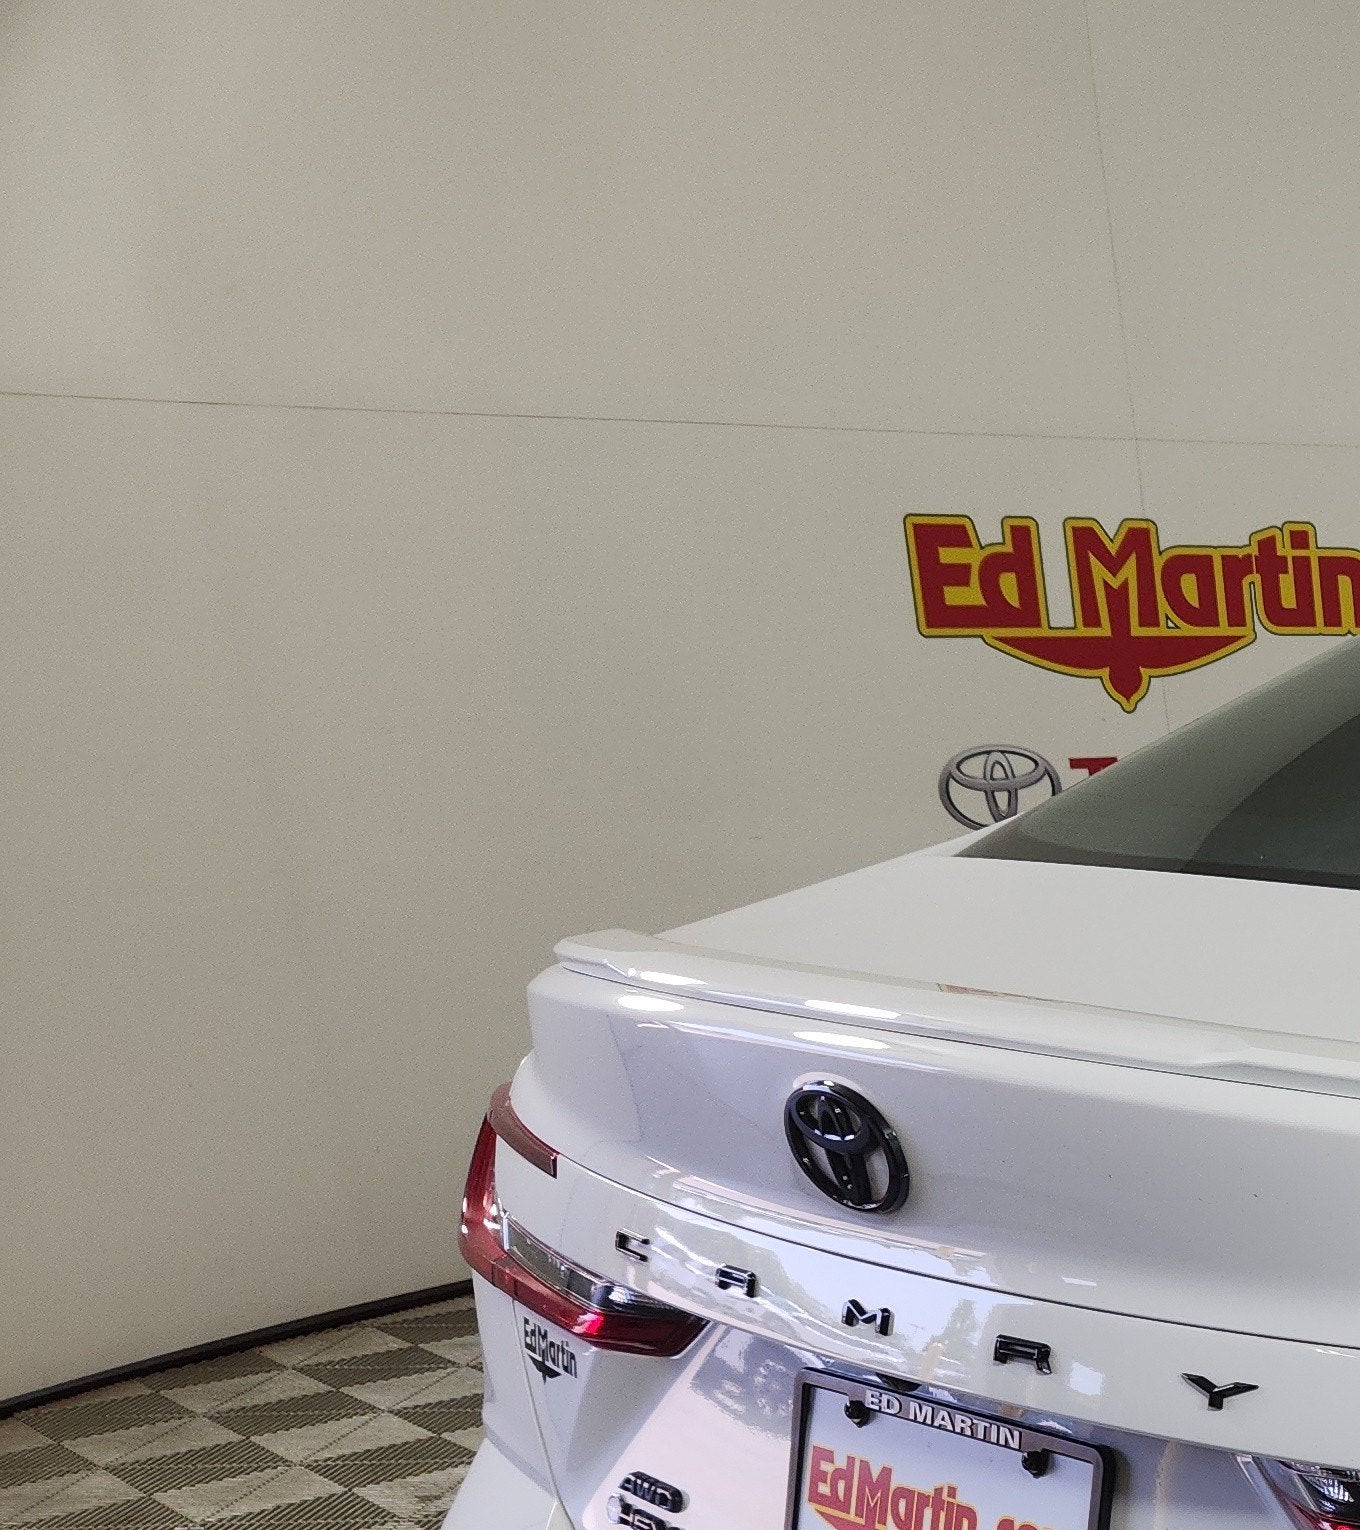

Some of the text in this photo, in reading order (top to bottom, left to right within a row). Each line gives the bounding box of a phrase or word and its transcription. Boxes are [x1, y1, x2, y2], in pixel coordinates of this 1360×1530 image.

[904, 514, 1049, 637] Ed
[615, 1228, 1260, 1410] CAMRY
[865, 1389, 1023, 1450] ED MARTIN
[618, 1471, 683, 1513] AWD
